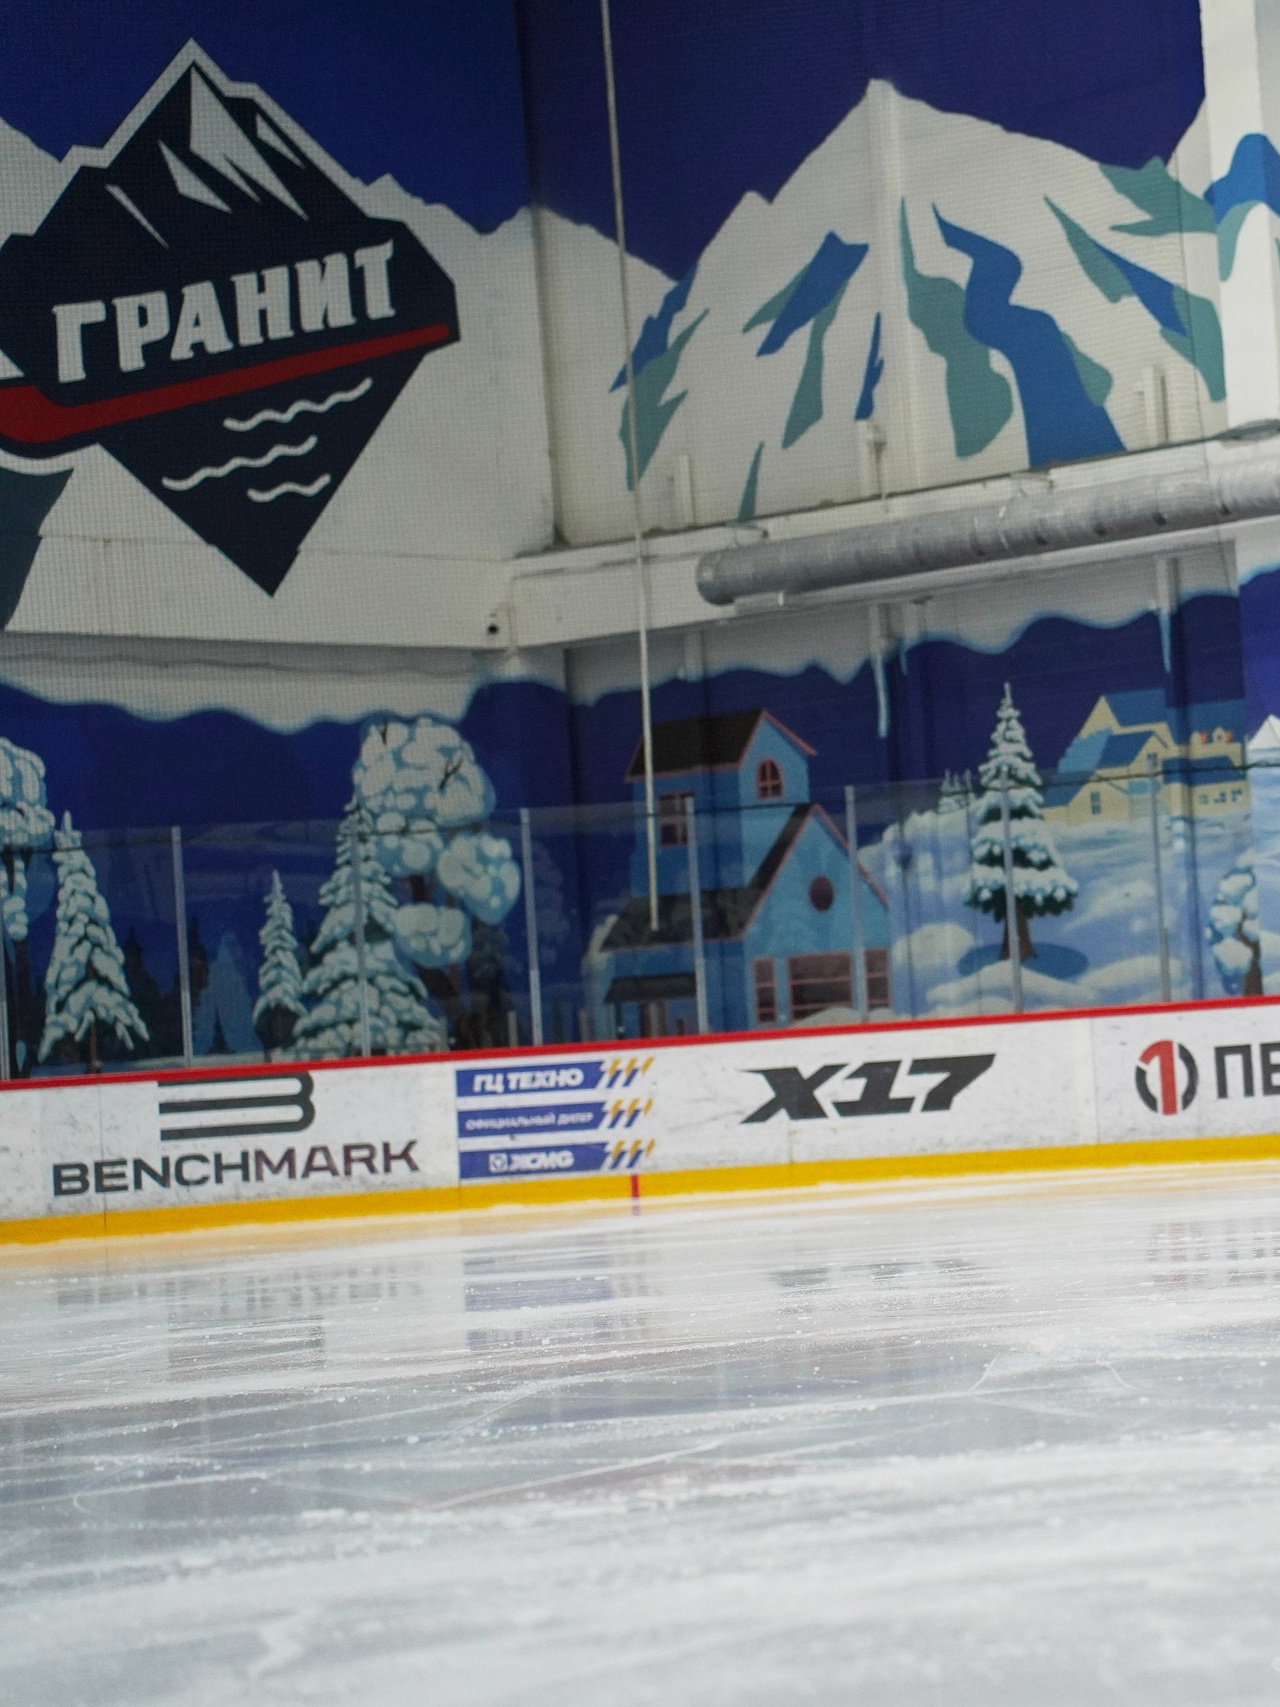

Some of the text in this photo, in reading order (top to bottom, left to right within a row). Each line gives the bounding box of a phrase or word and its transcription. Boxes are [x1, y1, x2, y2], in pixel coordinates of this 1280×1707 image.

[53, 239, 395, 383] ГРАНИТ
[473, 1067, 585, 1094] ГЦ ТЕХНО
[739, 1053, 997, 1125] X17
[53, 1139, 419, 1197] BENCHMARK
